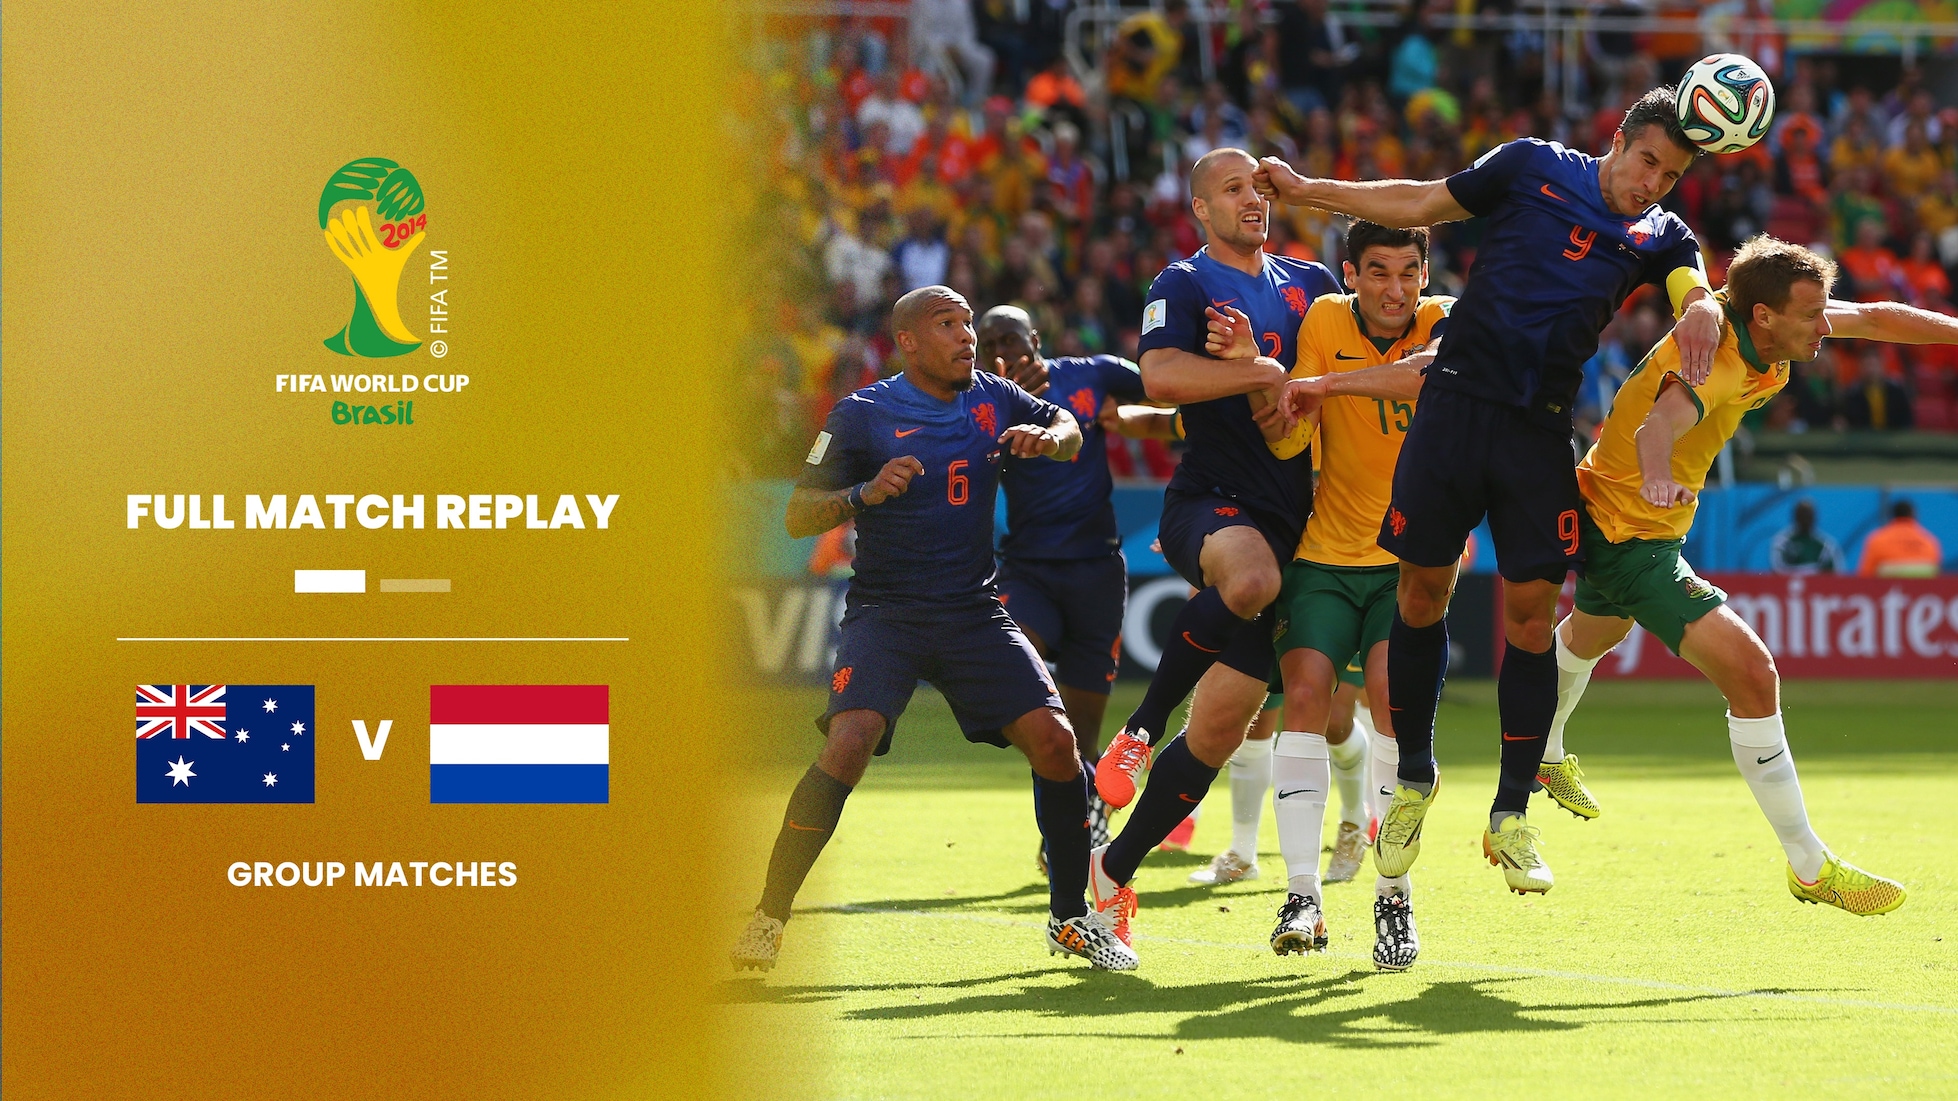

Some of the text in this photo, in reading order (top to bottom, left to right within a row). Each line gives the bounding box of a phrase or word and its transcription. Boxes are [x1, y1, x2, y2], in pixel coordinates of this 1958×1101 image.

[1562, 224, 1598, 262] 9
[1371, 397, 1414, 435] 15
[947, 459, 969, 506] 6
[1557, 508, 1580, 556] 9
[1726, 577, 1958, 659] mirates
